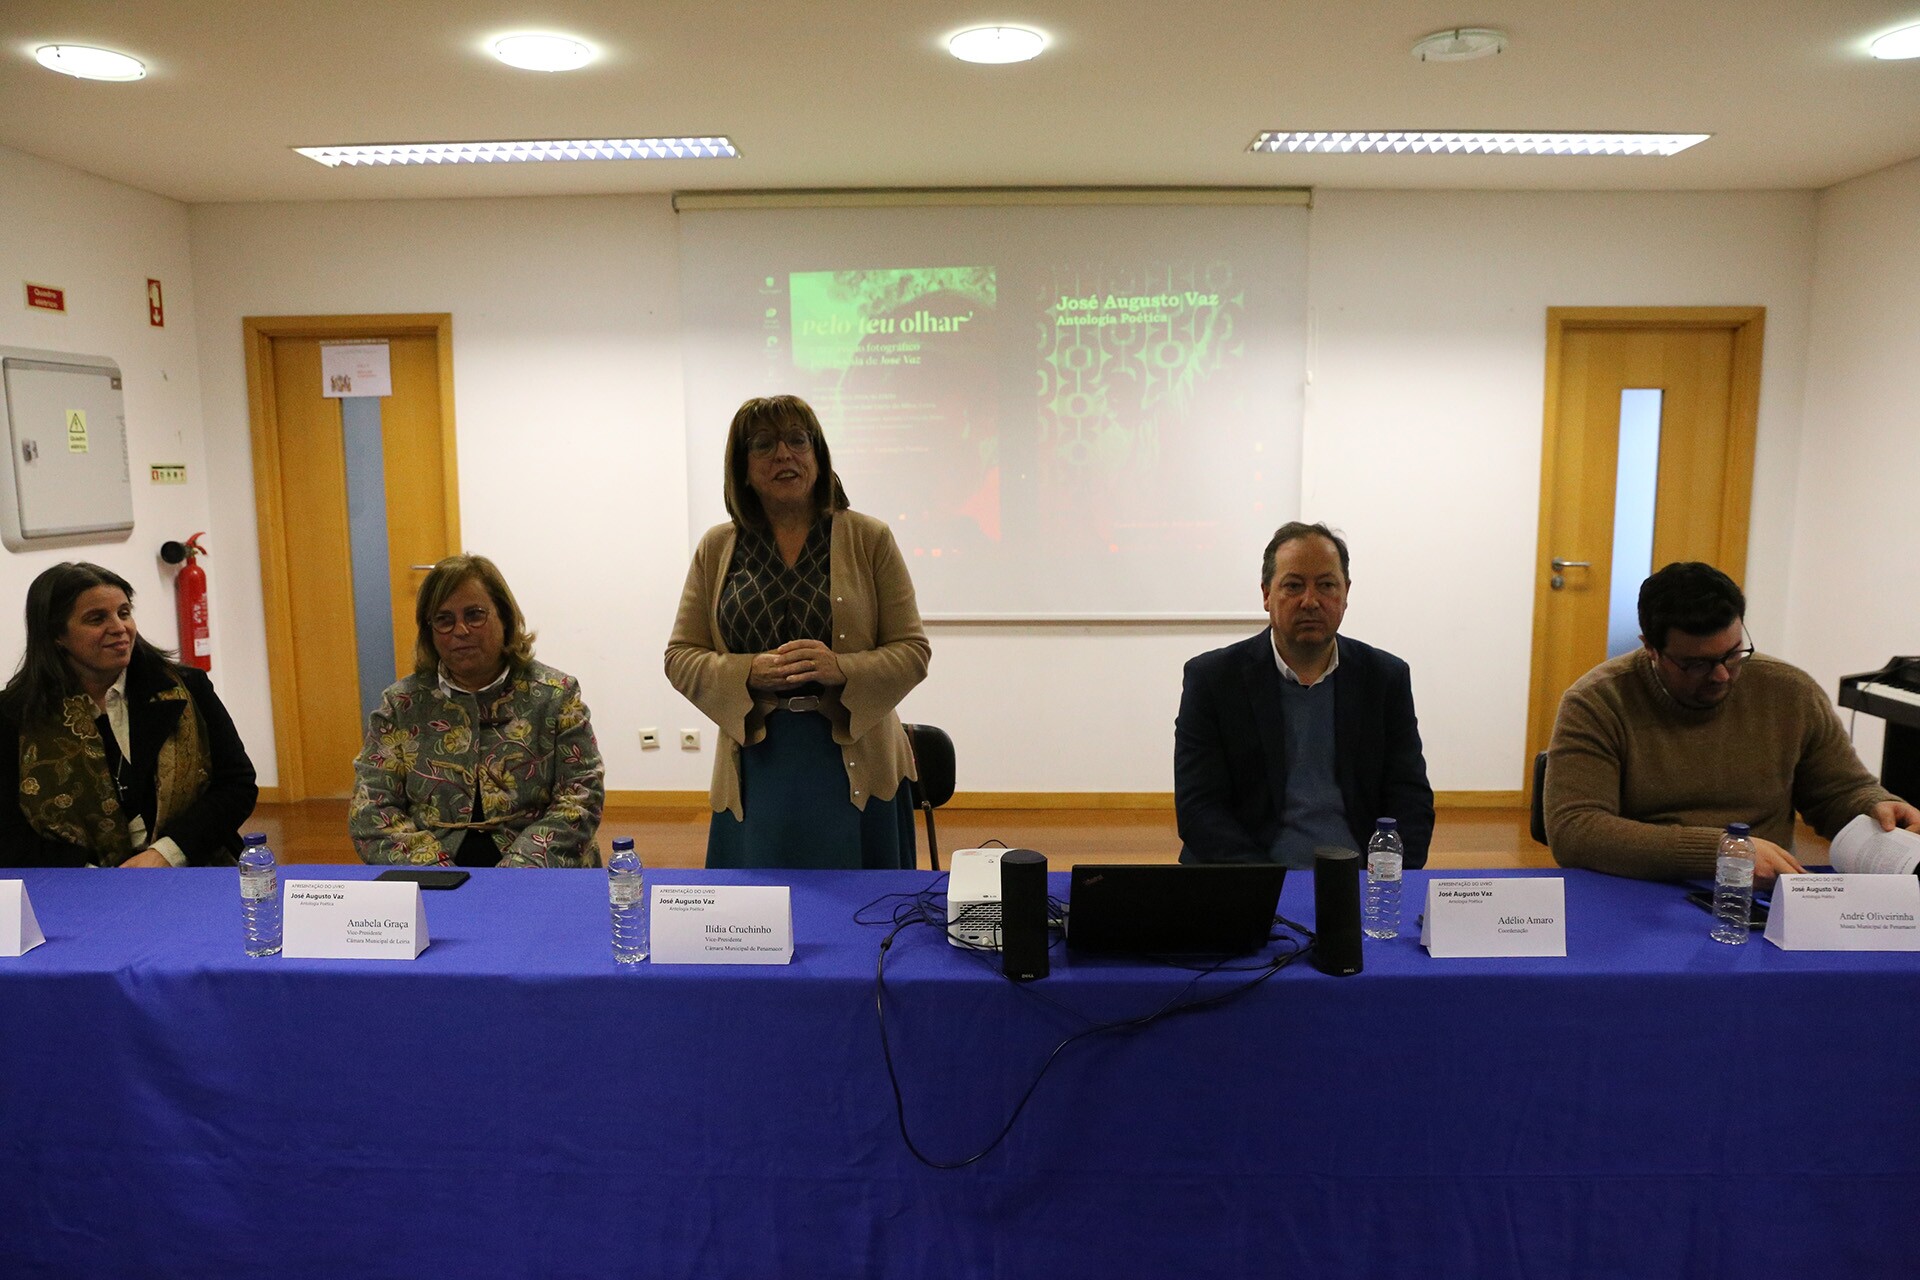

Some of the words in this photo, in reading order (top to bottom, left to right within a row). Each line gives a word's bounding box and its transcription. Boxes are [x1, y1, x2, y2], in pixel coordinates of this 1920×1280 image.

[1056, 294, 1098, 311] José
[1104, 294, 1180, 312] Augusto
[1185, 291, 1219, 306] Vaz
[1056, 314, 1118, 327] Antologia
[1120, 312, 1168, 324] Poética
[858, 316, 895, 335] teu
[880, 355, 902, 366] José
[904, 354, 921, 365] Vaz
[1498, 916, 1525, 925] Adélio
[1526, 916, 1554, 924] Amaro
[1840, 912, 1865, 920] André
[1866, 912, 1914, 921] Oliveirinha
[347, 919, 382, 928] Anabela
[384, 919, 409, 930] Graça
[705, 924, 727, 934] Ilídia
[729, 925, 772, 934] Cruchinho
